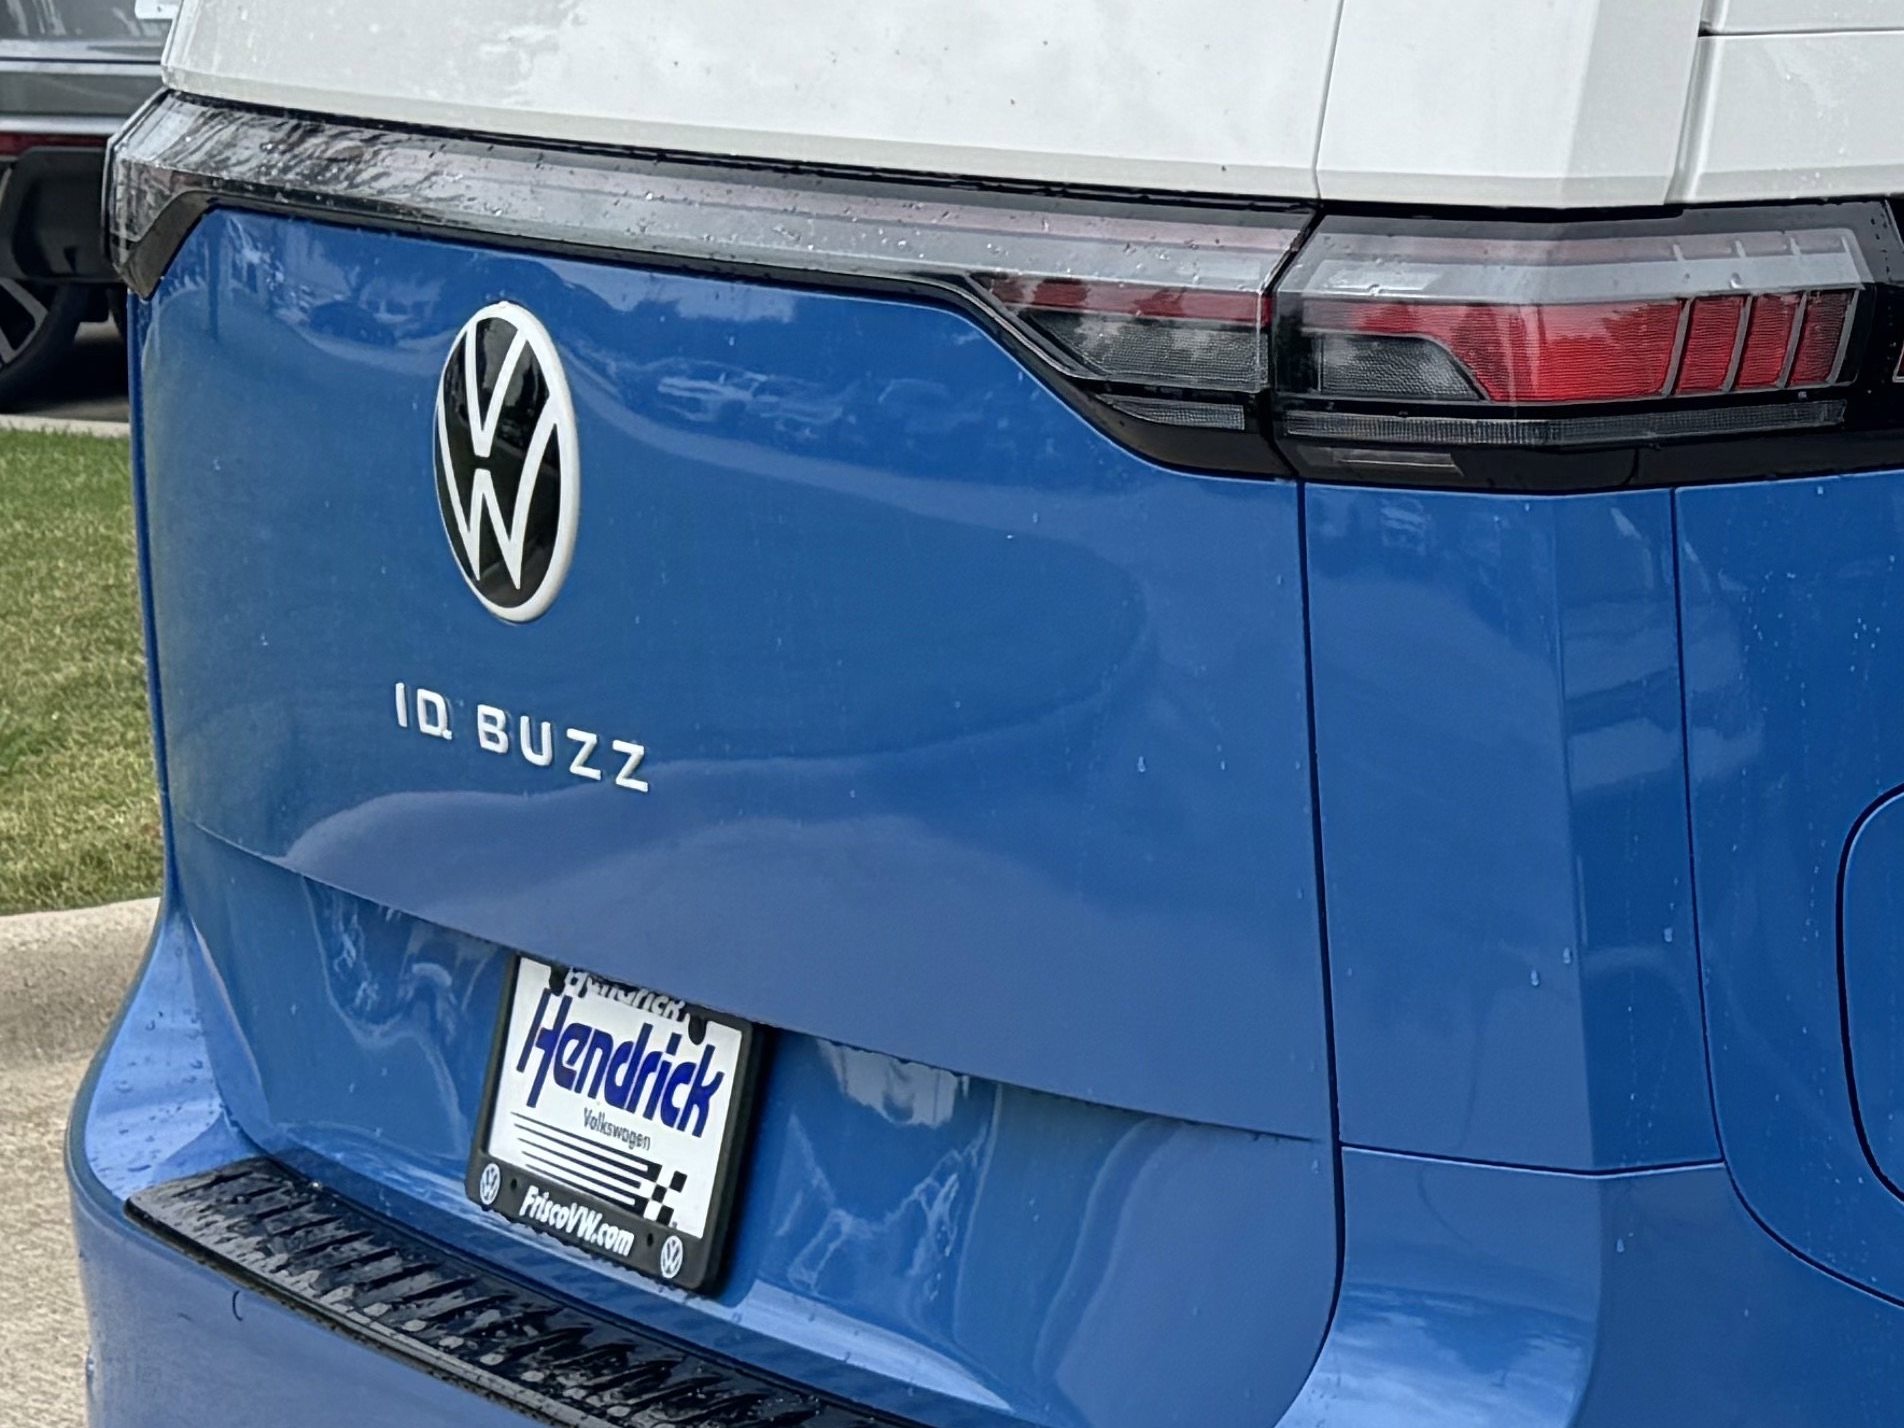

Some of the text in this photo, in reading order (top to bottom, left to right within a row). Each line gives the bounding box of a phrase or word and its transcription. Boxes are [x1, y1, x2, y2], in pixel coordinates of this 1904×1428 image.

[434, 302, 581, 623] VW
[477, 704, 649, 793] BUZZ
[516, 988, 725, 1138] Hendrick
[583, 1108, 651, 1150] Volkswagen
[519, 1186, 635, 1256] FriscoVW.com
